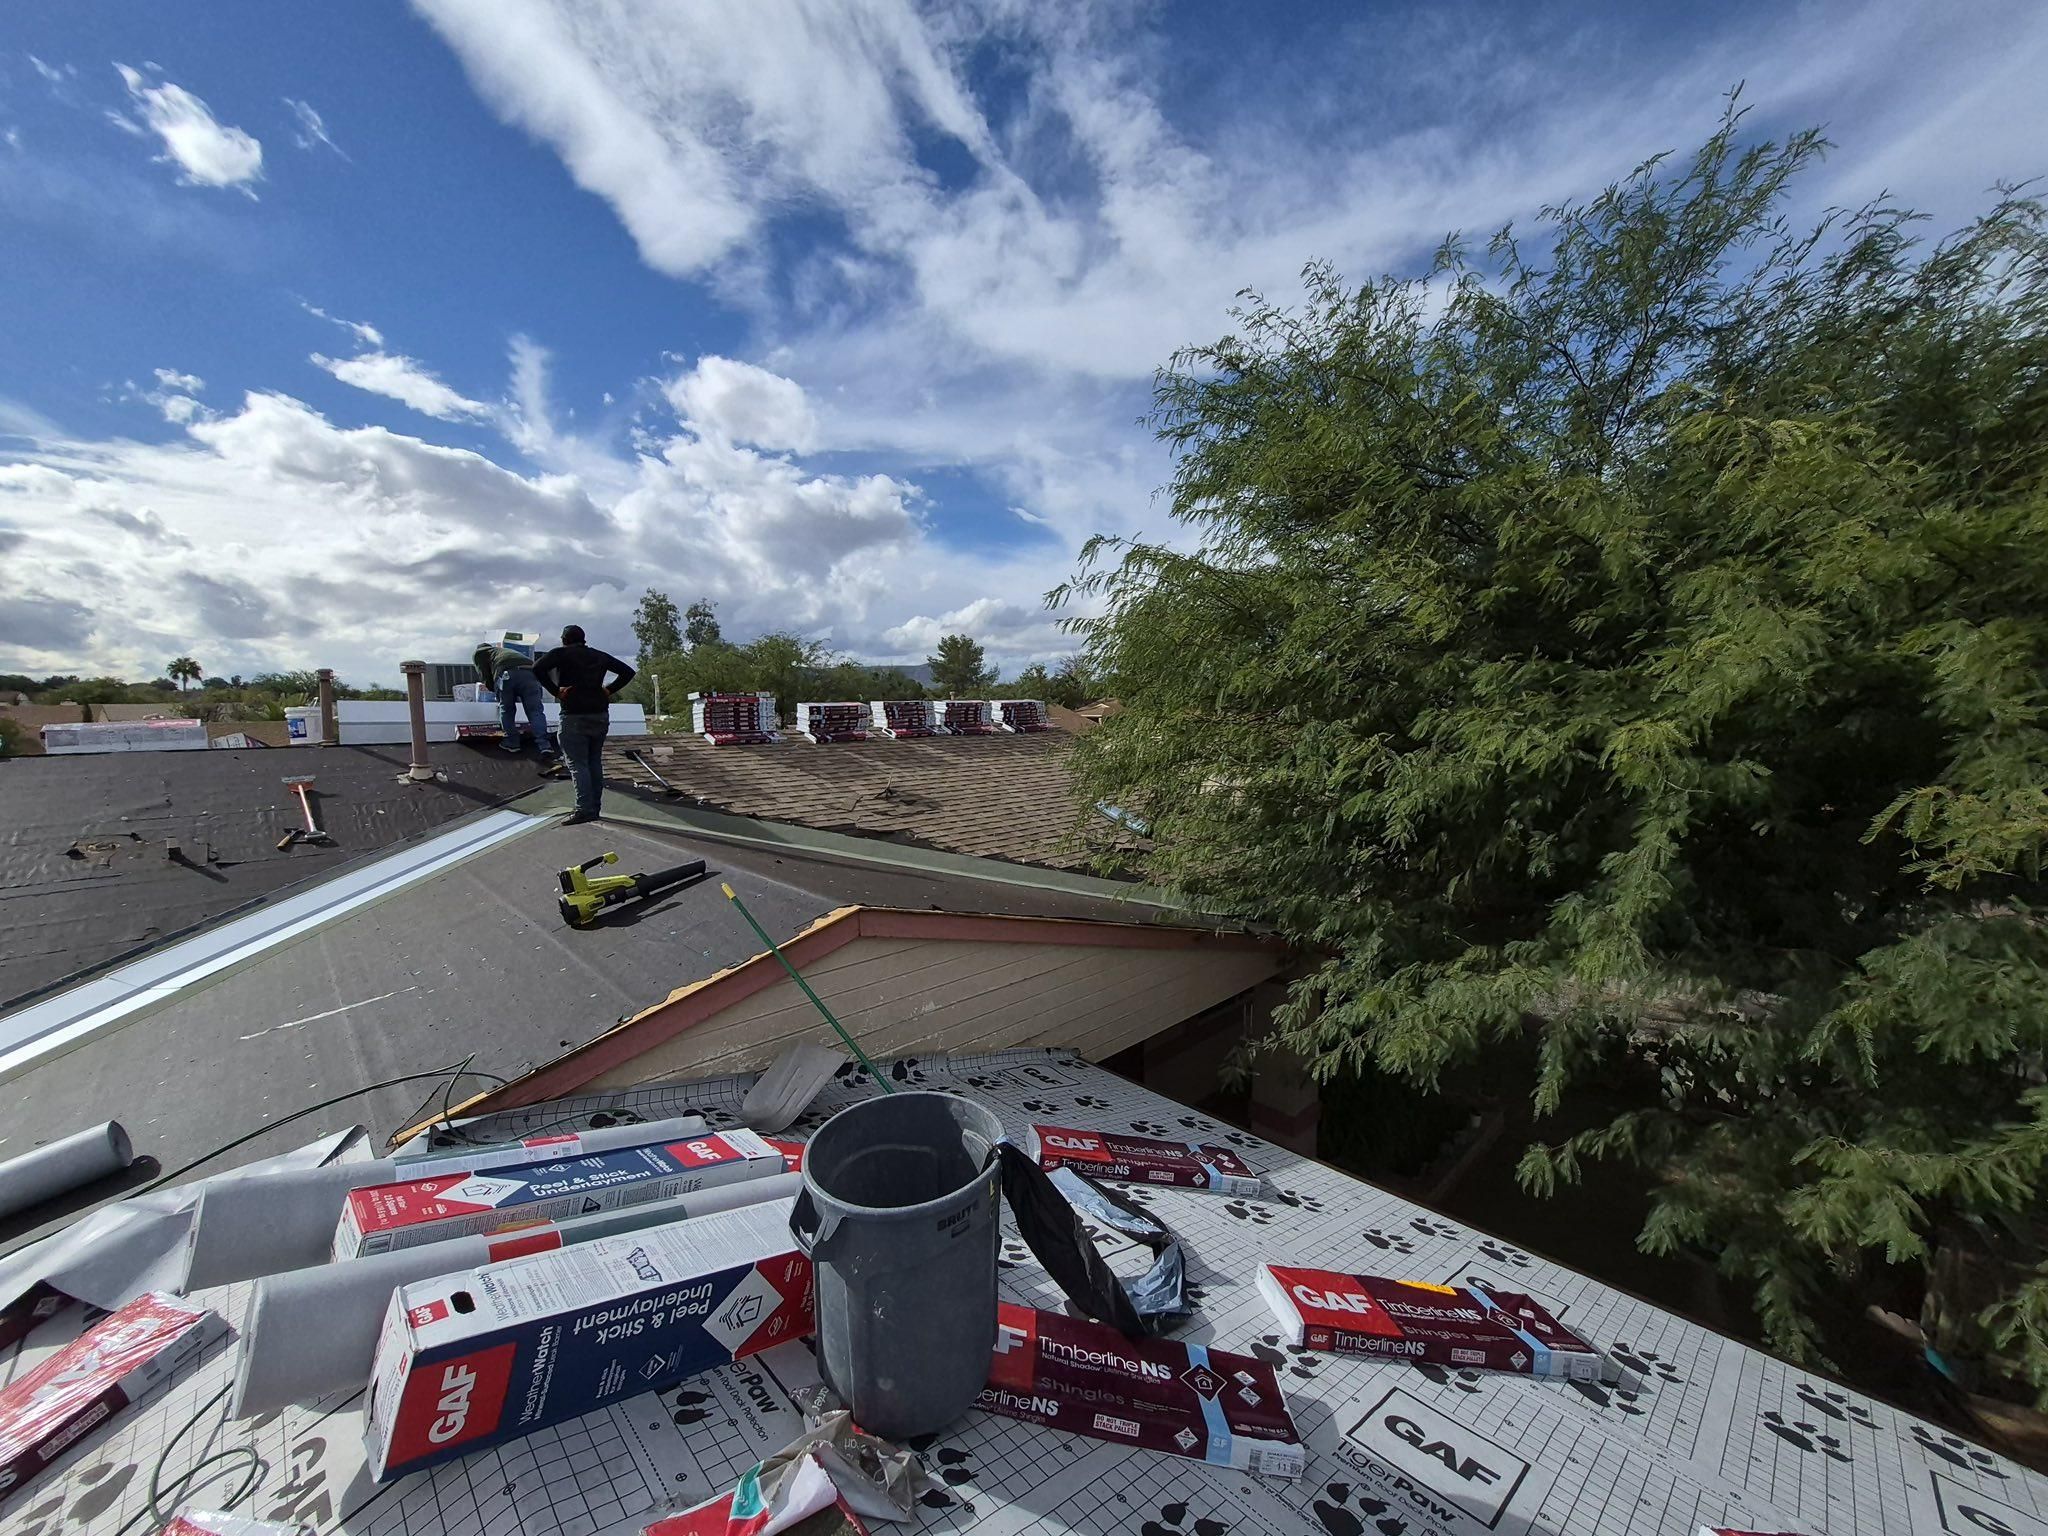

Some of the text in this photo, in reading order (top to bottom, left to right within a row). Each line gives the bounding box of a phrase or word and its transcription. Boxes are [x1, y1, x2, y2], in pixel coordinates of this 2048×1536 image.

[686, 1141, 722, 1161] GAF
[1045, 1135, 1099, 1150] GAF
[529, 1169, 630, 1191] Peel & Stick
[533, 1170, 652, 1197] Underlayment
[573, 1282, 713, 1336] Underlayment
[1292, 1284, 1372, 1314] GAF
[415, 1306, 434, 1326] GAF
[596, 1298, 711, 1345] Peel & Stick
[1310, 1333, 1329, 1343] GAF
[1334, 1330, 1426, 1356] TimberlineNS
[1042, 1352, 1069, 1366] Natural
[518, 1325, 553, 1426] WeatherWatch
[730, 1361, 779, 1413] erPaw
[428, 1364, 477, 1444] GAF
[976, 1389, 1059, 1417] erlineNS
[1040, 1376, 1125, 1405] Shingles
[742, 1406, 769, 1442] Protection
[1095, 1421, 1138, 1435] STACK PALLETS
[1120, 1421, 1138, 1429] TRIPLE
[1213, 1438, 1227, 1449] SF
[1384, 1415, 1501, 1486] GAF
[1332, 1452, 1373, 1482] Premium
[1374, 1480, 1398, 1498] Roof
[1399, 1497, 1424, 1517] Deck
